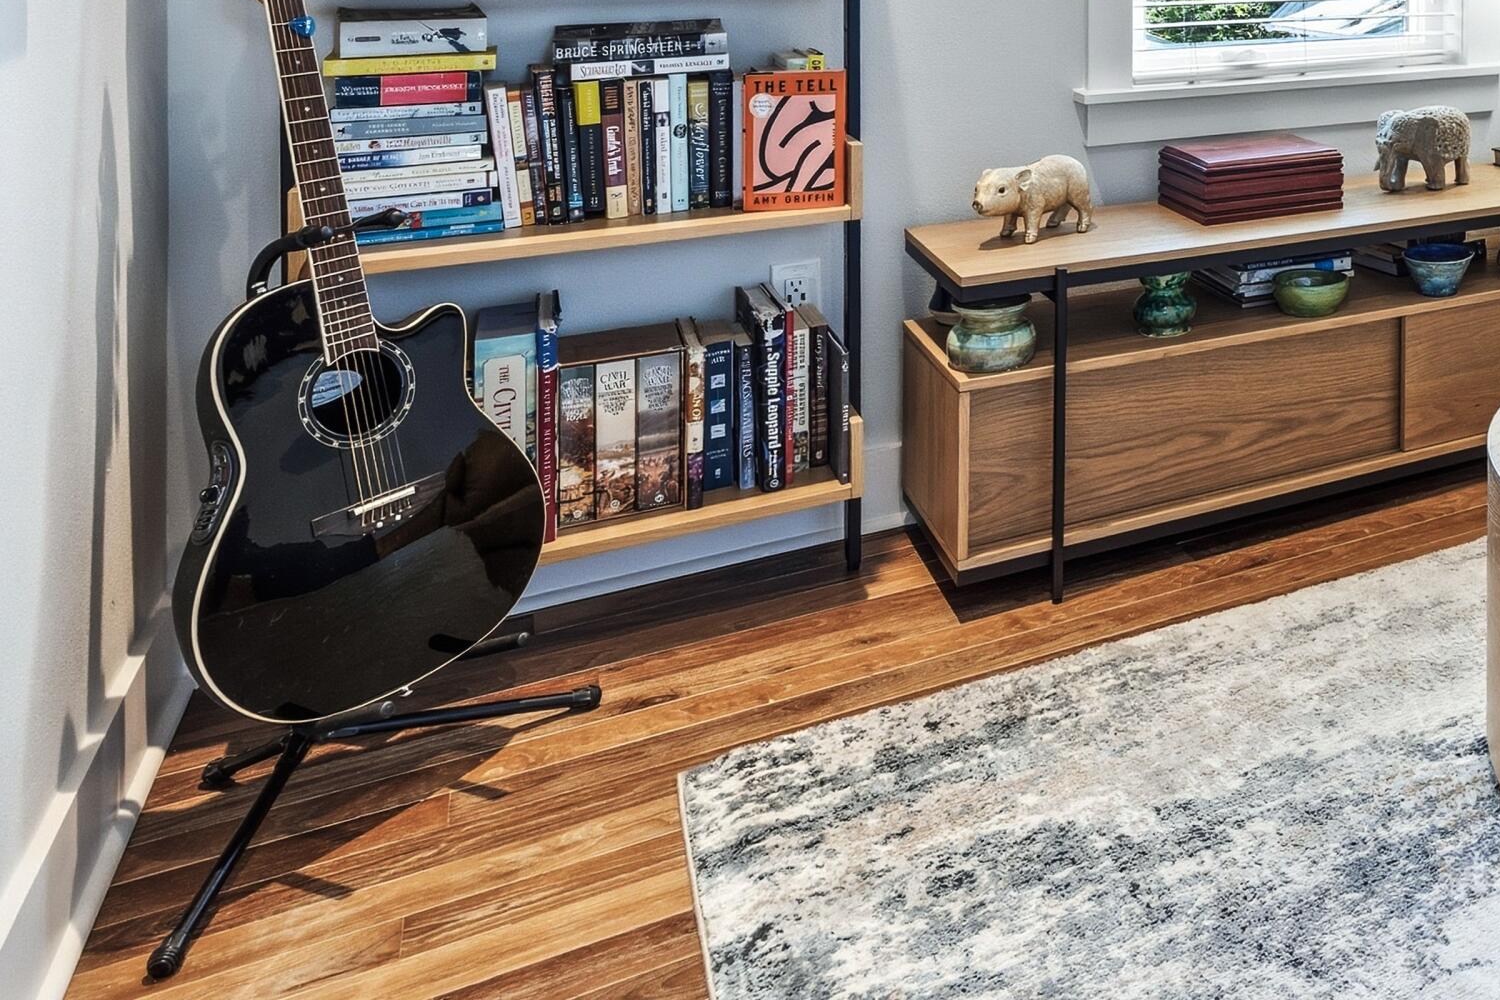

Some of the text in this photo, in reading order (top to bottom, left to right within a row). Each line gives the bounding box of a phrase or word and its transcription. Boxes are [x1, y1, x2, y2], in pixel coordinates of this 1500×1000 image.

[556, 36, 682, 59] BRUCE SPRINGSTEEN
[539, 74, 556, 117] VENGEANCE
[753, 79, 838, 93] THE TELL
[694, 102, 710, 185] Mayflower
[753, 193, 835, 205] AMY GRIFFIN
[499, 364, 511, 385] THE
[600, 370, 631, 385] CIVIL
[764, 352, 781, 450] Supple Leopard
